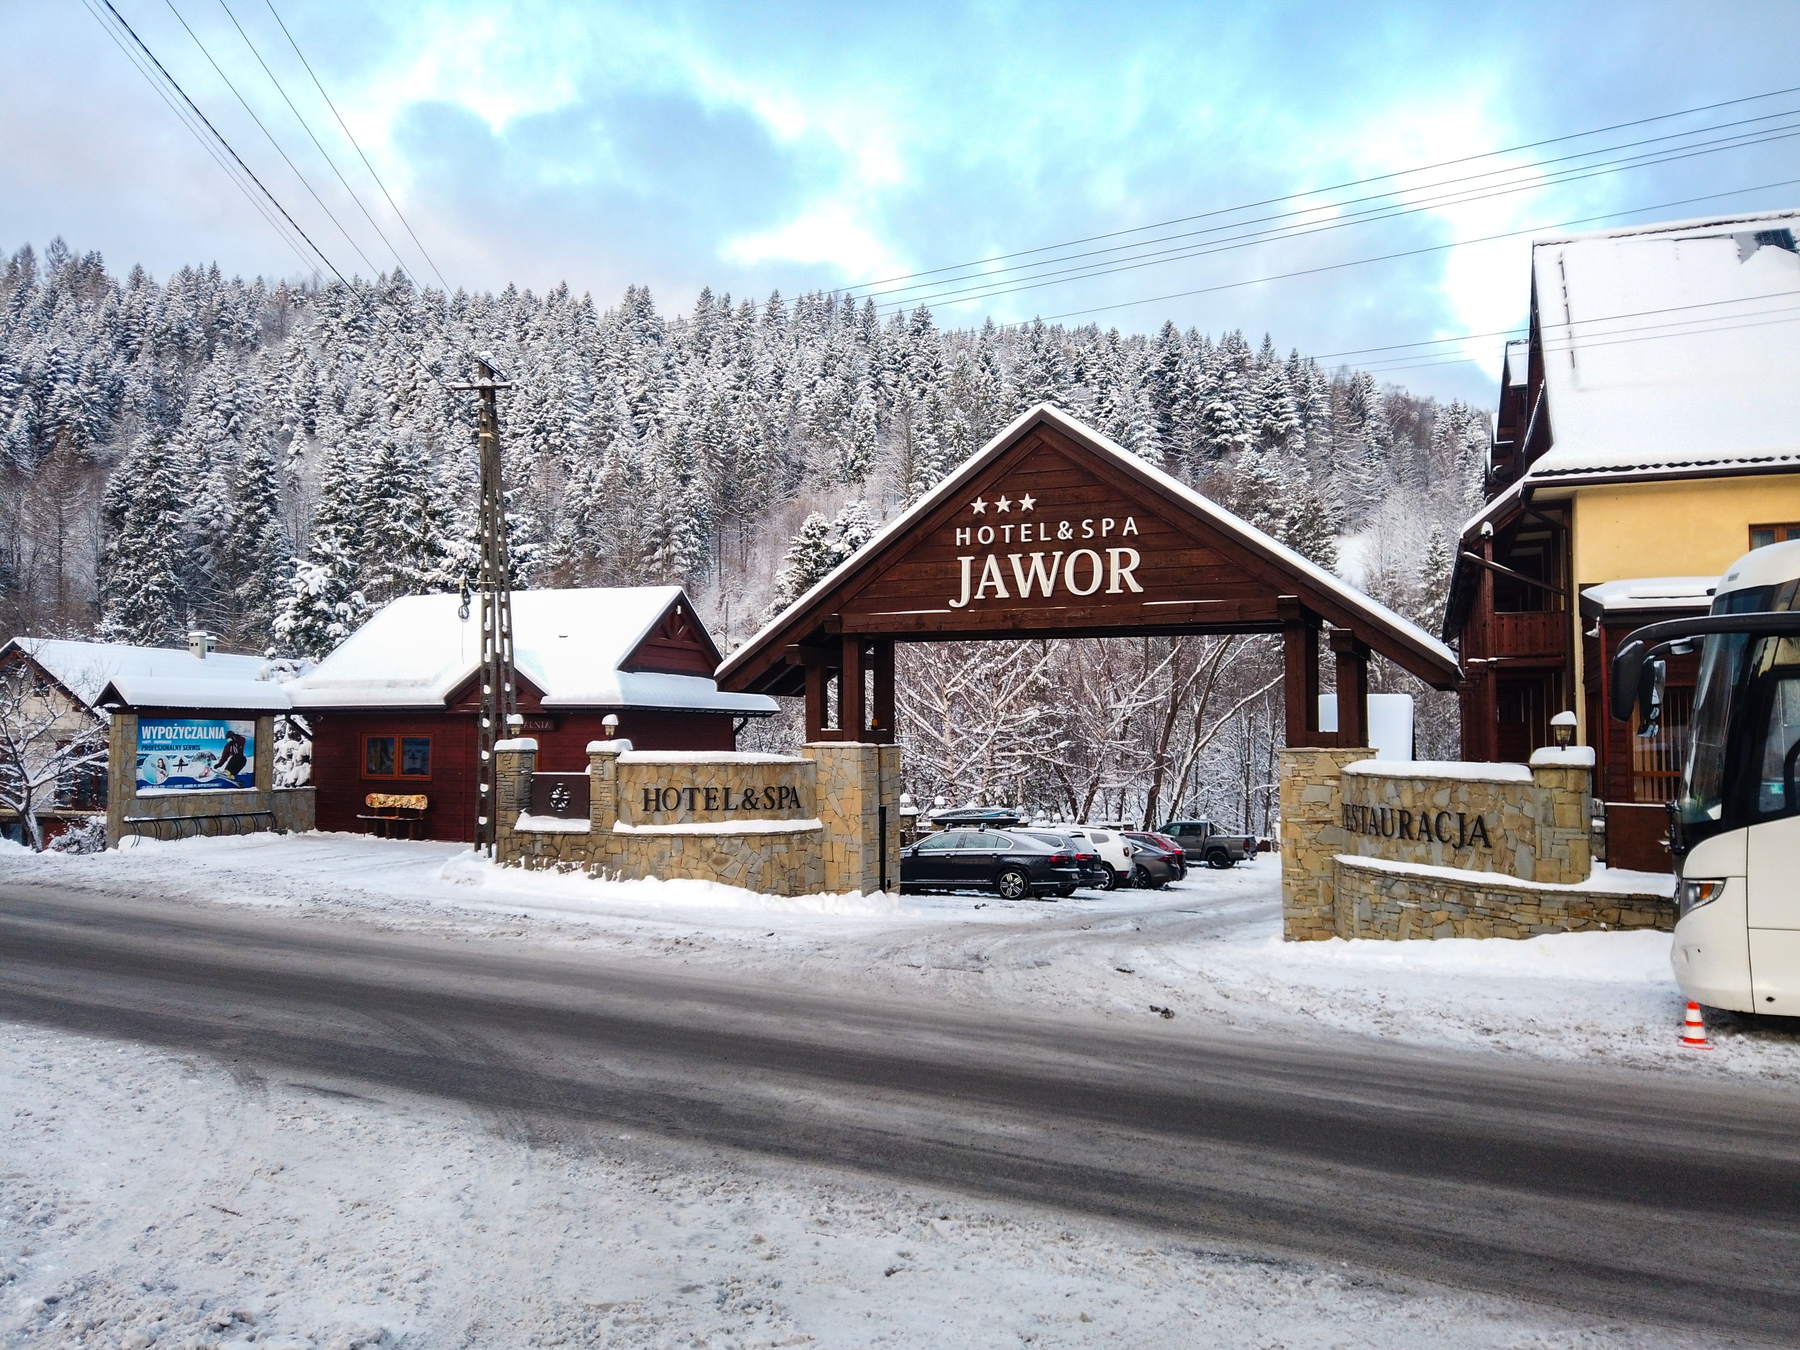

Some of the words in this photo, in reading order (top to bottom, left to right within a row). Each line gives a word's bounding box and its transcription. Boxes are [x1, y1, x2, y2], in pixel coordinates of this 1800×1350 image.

[948, 547, 1144, 608] JAWOR
[141, 723, 226, 740] WYPOŻYCZALNIA
[642, 785, 802, 812] HOTEL&SPA
